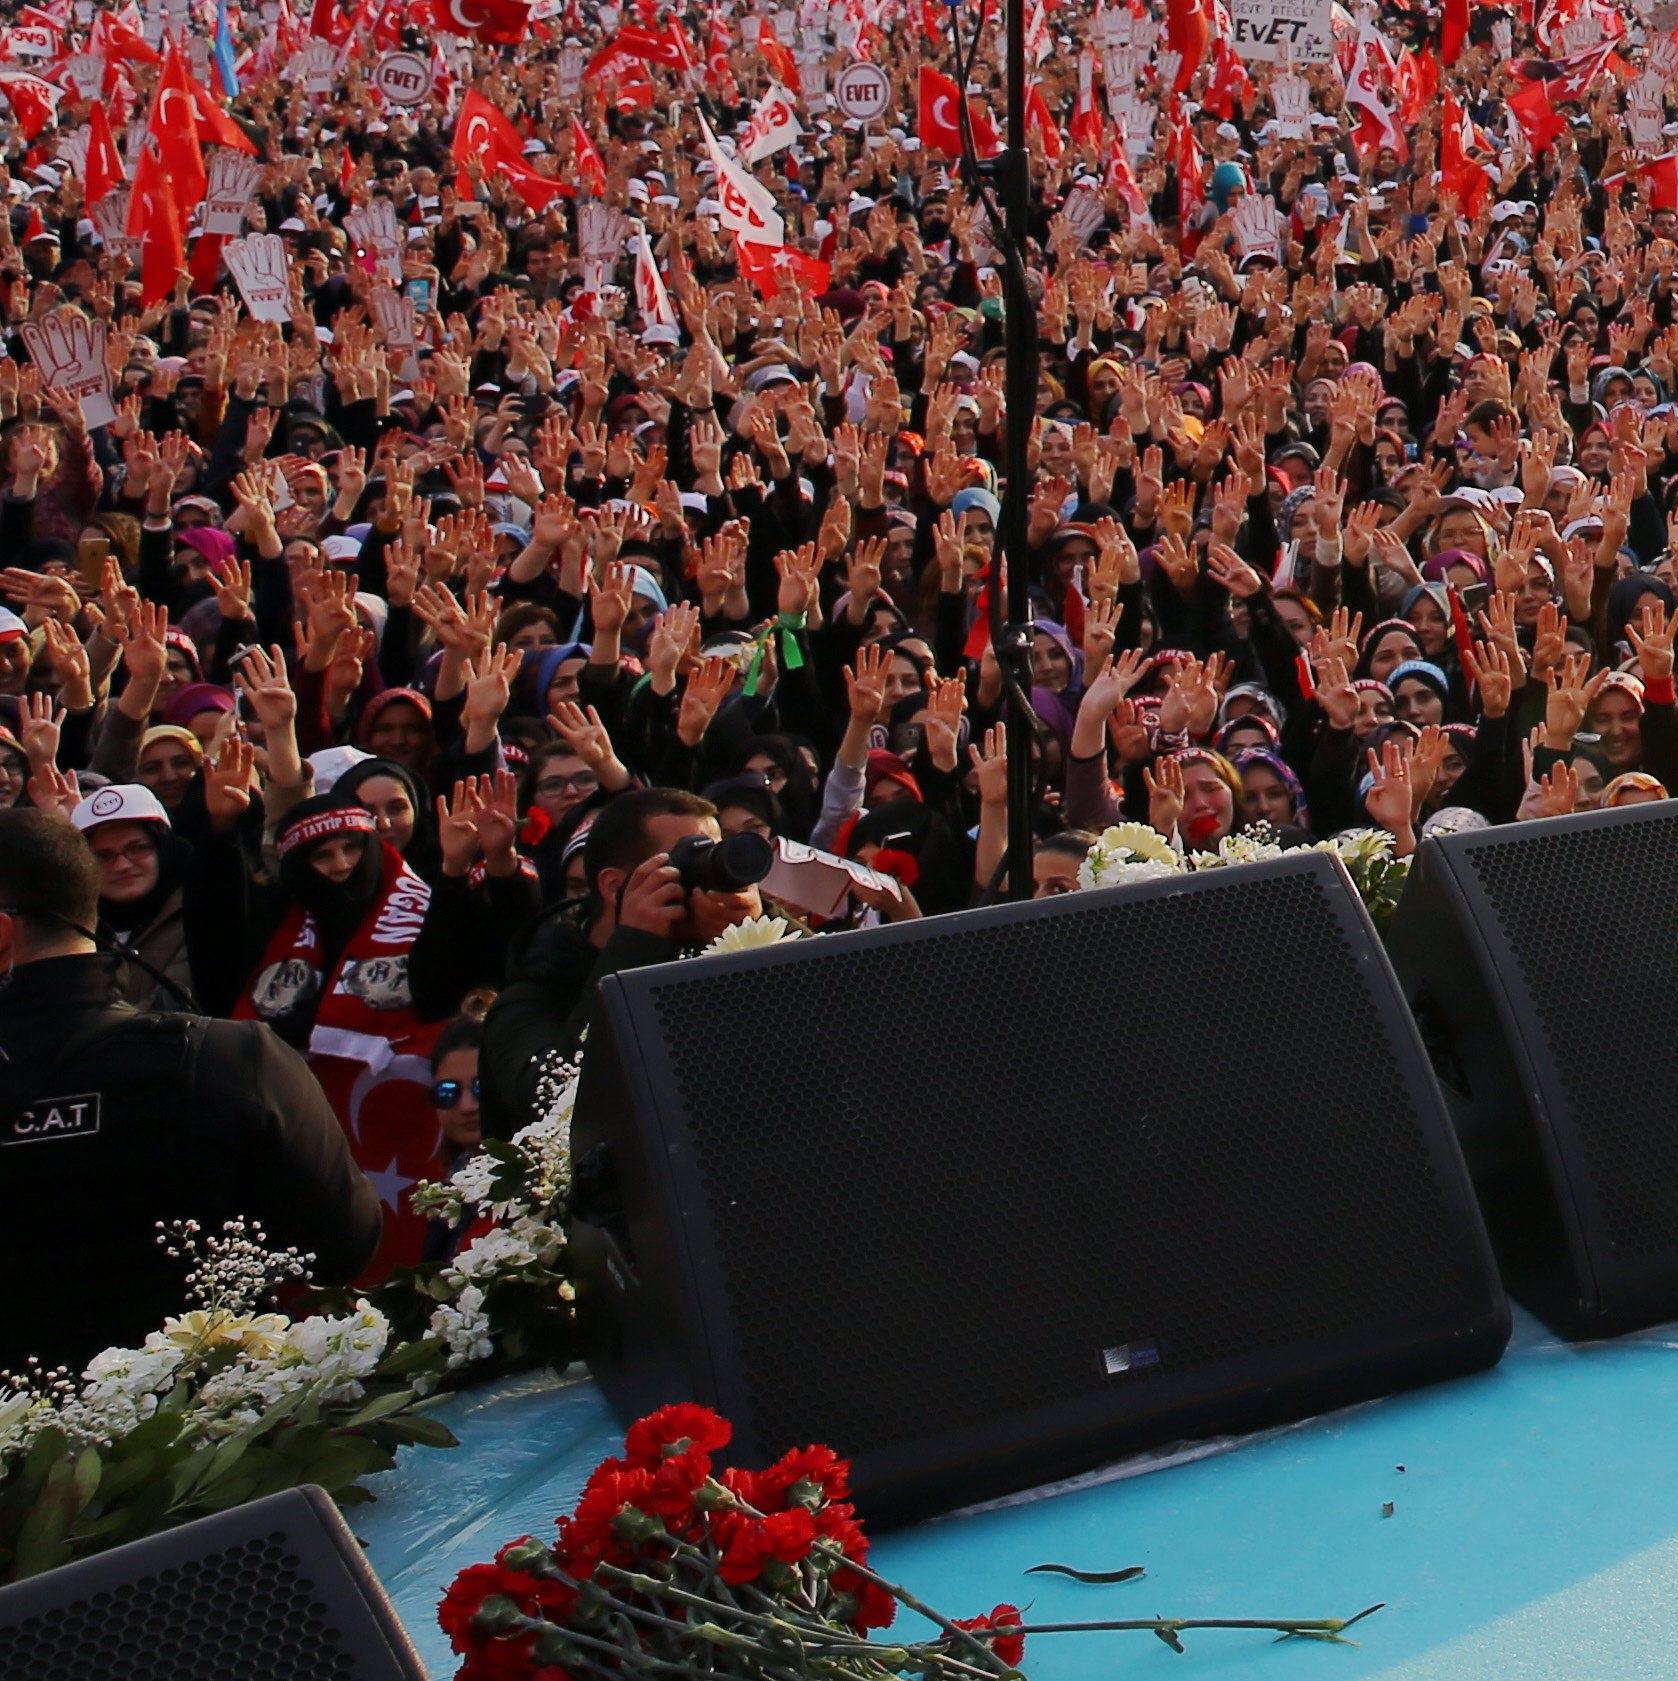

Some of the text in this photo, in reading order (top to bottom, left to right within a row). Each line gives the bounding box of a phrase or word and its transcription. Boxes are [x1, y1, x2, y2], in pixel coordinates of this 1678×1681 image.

[1235, 18, 1308, 44] EVET
[384, 71, 423, 92] EVET
[846, 84, 881, 102] EVET
